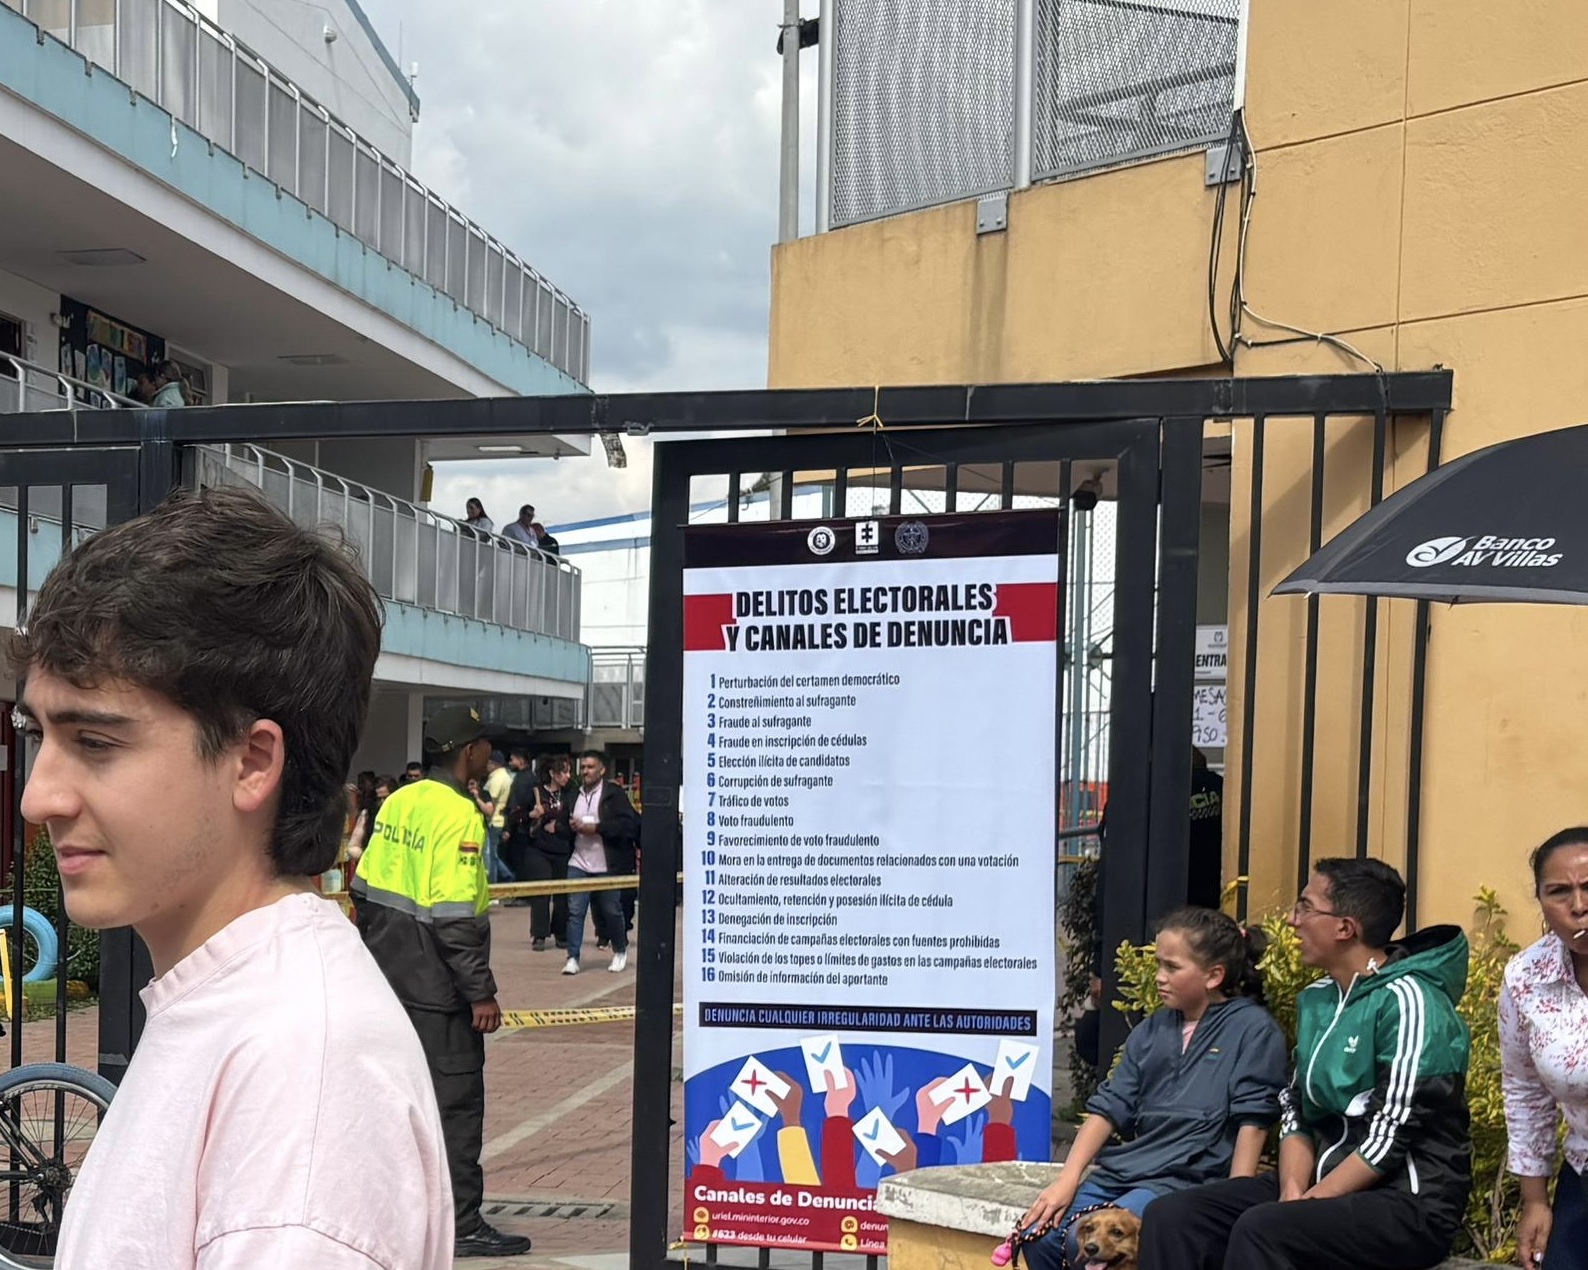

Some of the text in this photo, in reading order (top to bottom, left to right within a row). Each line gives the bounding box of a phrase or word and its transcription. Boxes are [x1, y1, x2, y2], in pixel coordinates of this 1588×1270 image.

[1473, 536, 1555, 550] Banco
[1451, 551, 1563, 567] AV Villas
[736, 584, 992, 617] DELITOS ELECTORALES
[726, 619, 1008, 651] Y CANALES DE DENUNCIA
[711, 673, 900, 689] 1 Perturbación del certamen democrático
[708, 694, 856, 709] 2 Constreñimiento al sufragante
[708, 713, 811, 730] 3 Fraude al sufragante
[707, 733, 867, 749] 4 Fraude en inscripción de cédulas
[708, 753, 850, 768] 5 Elección ilícita de candidatos
[707, 772, 833, 789] 6 Corrupción de sufragante
[708, 792, 789, 807] 7 Tráfico de votos
[707, 812, 794, 827] 8 Voto fraudulento
[374, 821, 425, 853] POLICÍA
[707, 831, 879, 846] 9 Favorecimiento de voto fraudulento
[702, 851, 1019, 868] 10 Mora en la entrega de documentos relacionados con una votación
[705, 871, 881, 886] 11 Alteración de resultados electorales
[702, 890, 953, 908] 12 Ocultamiento, retención y posesión ilícita de cédula
[702, 909, 837, 928] 13 Denegación de inscripción
[702, 929, 1000, 950] 14 Financiación de campañas electorales con fuentes prohibidas
[702, 948, 1037, 970] 15 Violación de los topes o límites de gastos en las campañas electorales
[702, 967, 888, 987] 16 Omisión de información del aportante
[705, 1008, 1031, 1030] DENUNCIA CUALQUIER IRREGULARIDAD ANTE LAS AUTORIDADES
[694, 1186, 765, 1204] Canales
[770, 1190, 792, 1206] de
[738, 1232, 764, 1241] desde
[767, 1234, 776, 1242] tu
[778, 1234, 807, 1244] celular
